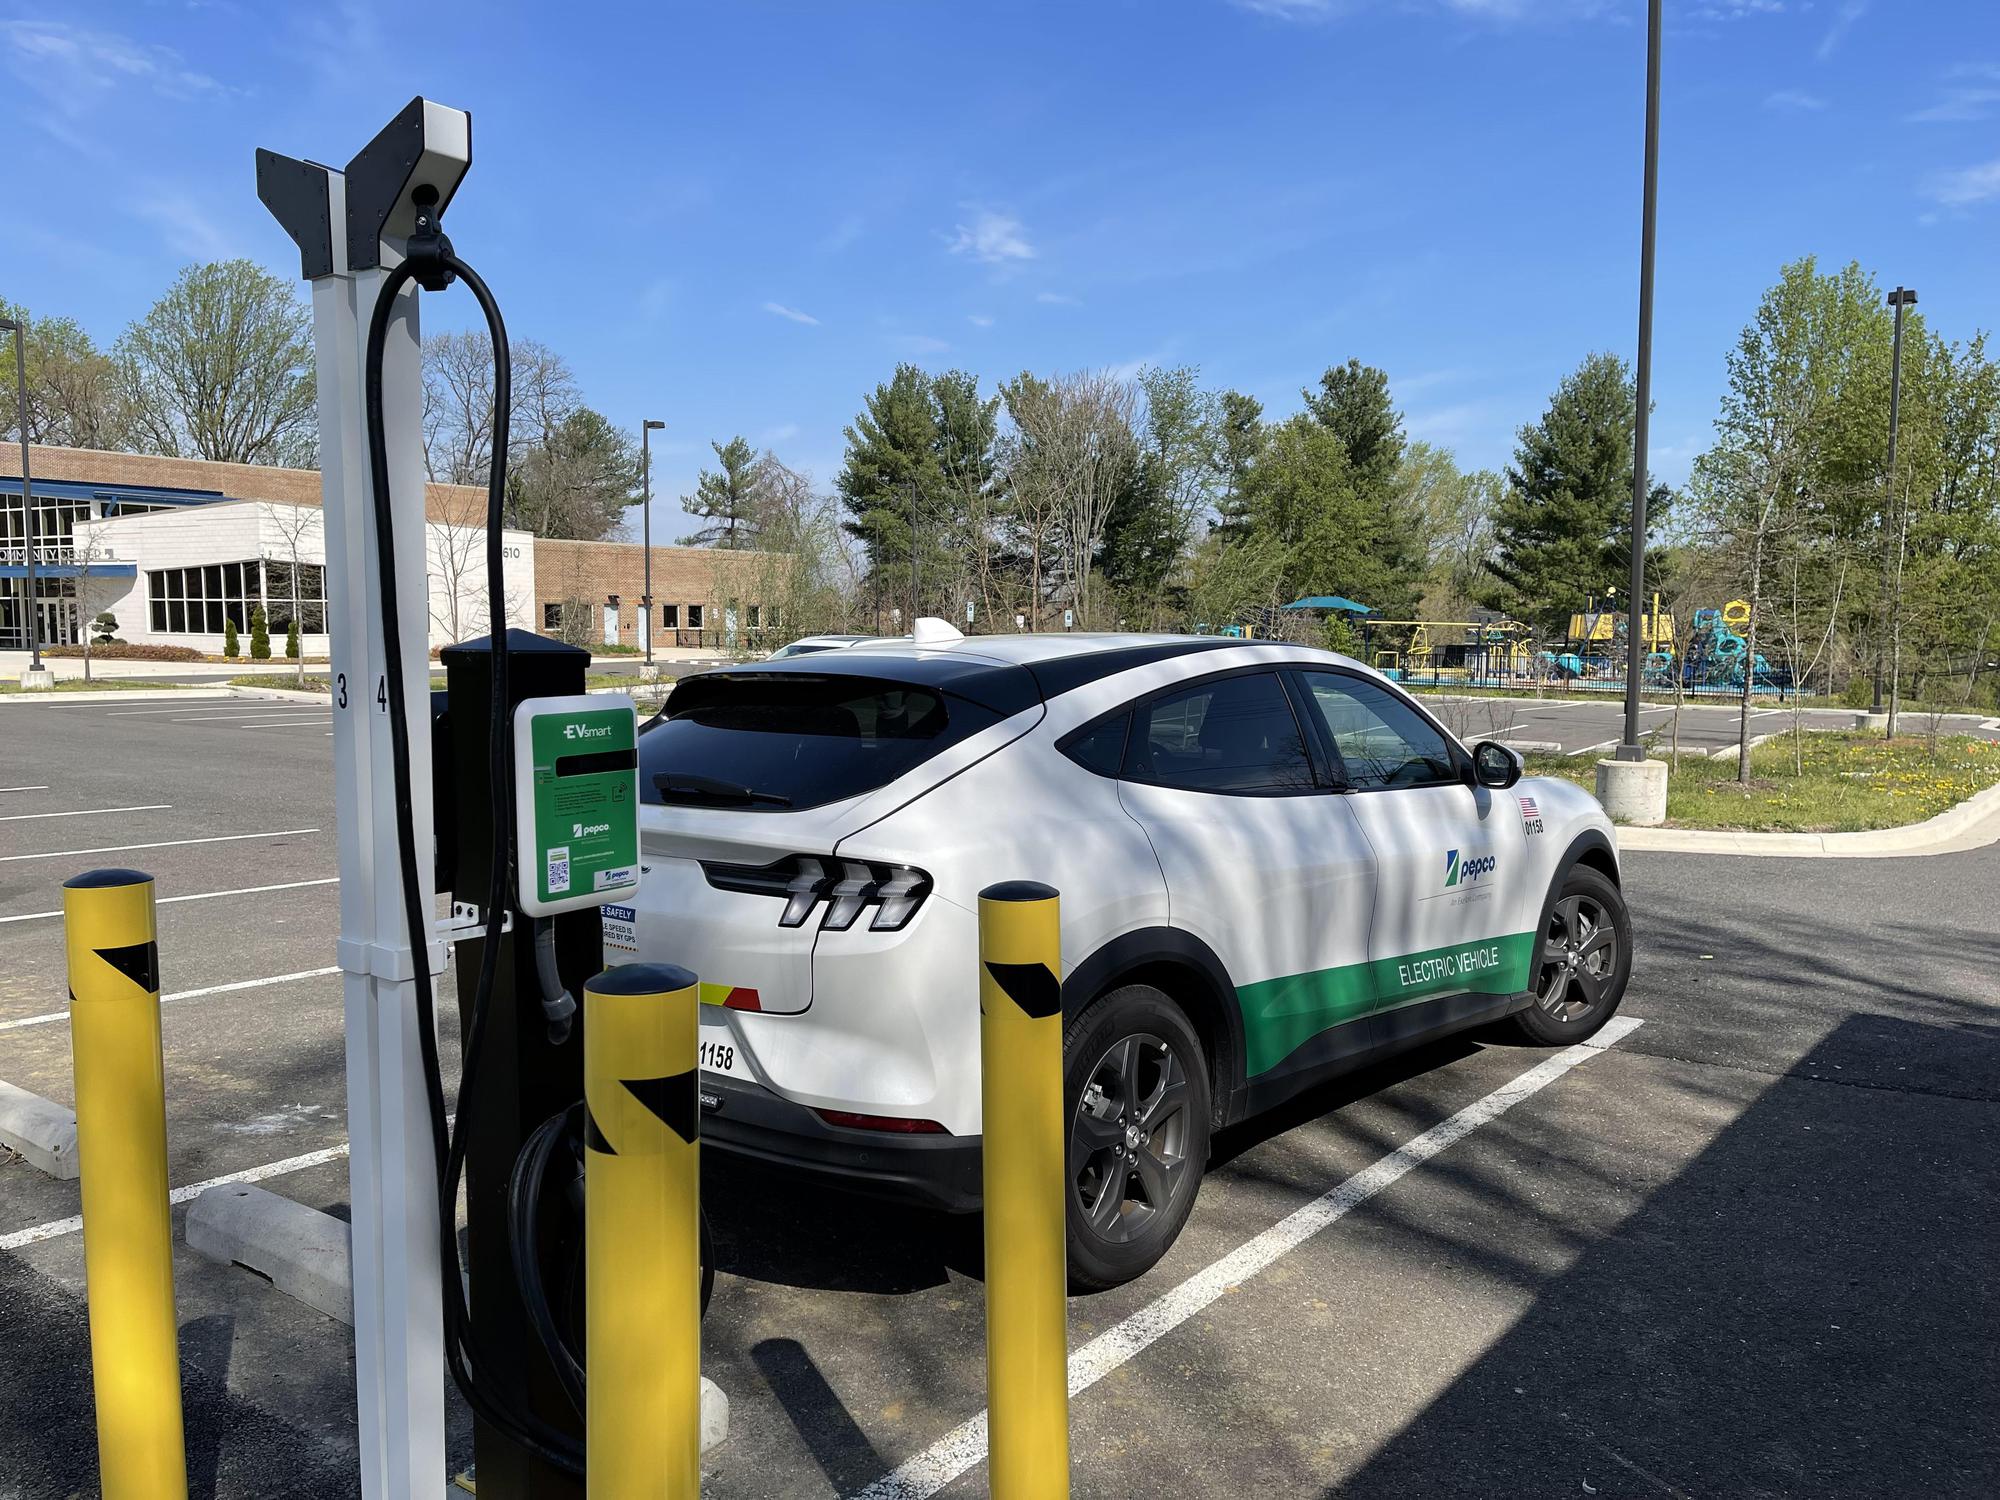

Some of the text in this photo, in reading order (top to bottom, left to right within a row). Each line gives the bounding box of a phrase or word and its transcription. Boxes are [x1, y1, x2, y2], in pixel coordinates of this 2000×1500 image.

[503, 547, 520, 559] 610
[338, 673, 347, 709] 3
[377, 675, 387, 712] 4
[563, 724, 612, 739] EVsmart
[583, 824, 609, 837] pepco
[1525, 819, 1543, 836] 01158
[611, 870, 629, 879] pepco
[1460, 855, 1496, 884] pepco
[606, 907, 632, 919] SAFELY
[609, 924, 626, 933] SPEED
[624, 935, 636, 943] GPS
[1399, 947, 1499, 986] ELECTRIC VEHICLE
[700, 1041, 734, 1070] 1158
